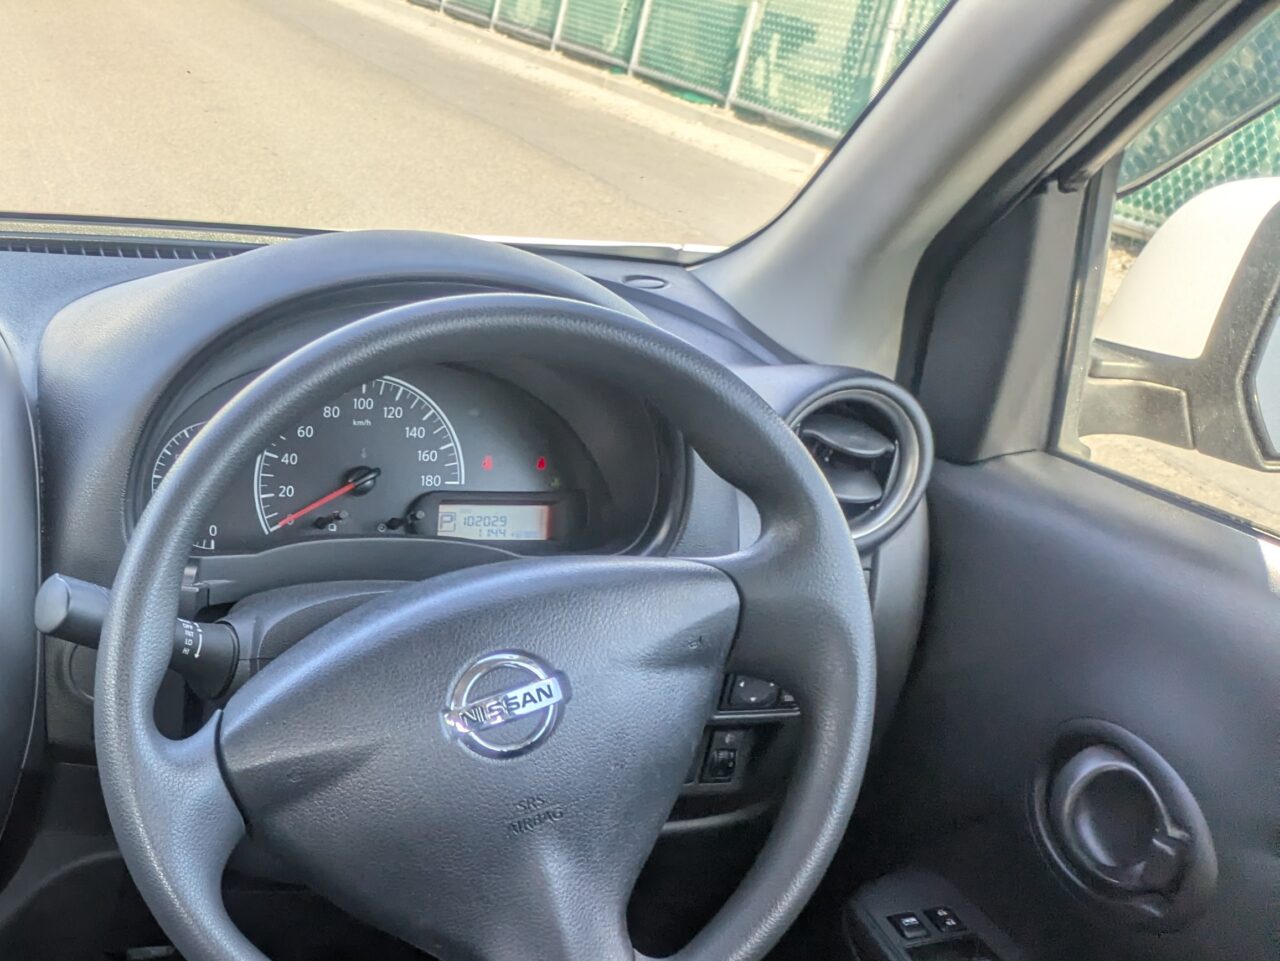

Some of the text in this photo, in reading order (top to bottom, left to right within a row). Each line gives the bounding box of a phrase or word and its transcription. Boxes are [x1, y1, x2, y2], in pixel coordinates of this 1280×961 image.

[353, 398, 373, 410] 100
[323, 406, 340, 418] 80
[384, 407, 403, 419] 120
[297, 426, 314, 438] 60
[405, 427, 425, 439] 140
[281, 453, 298, 465] 40
[418, 450, 438, 462] 160
[420, 475, 441, 487] 180
[278, 485, 294, 498] 20
[463, 515, 508, 527] 102029
[209, 525, 217, 536] 0
[459, 684, 554, 727] NISSAN
[516, 795, 546, 811] SRS
